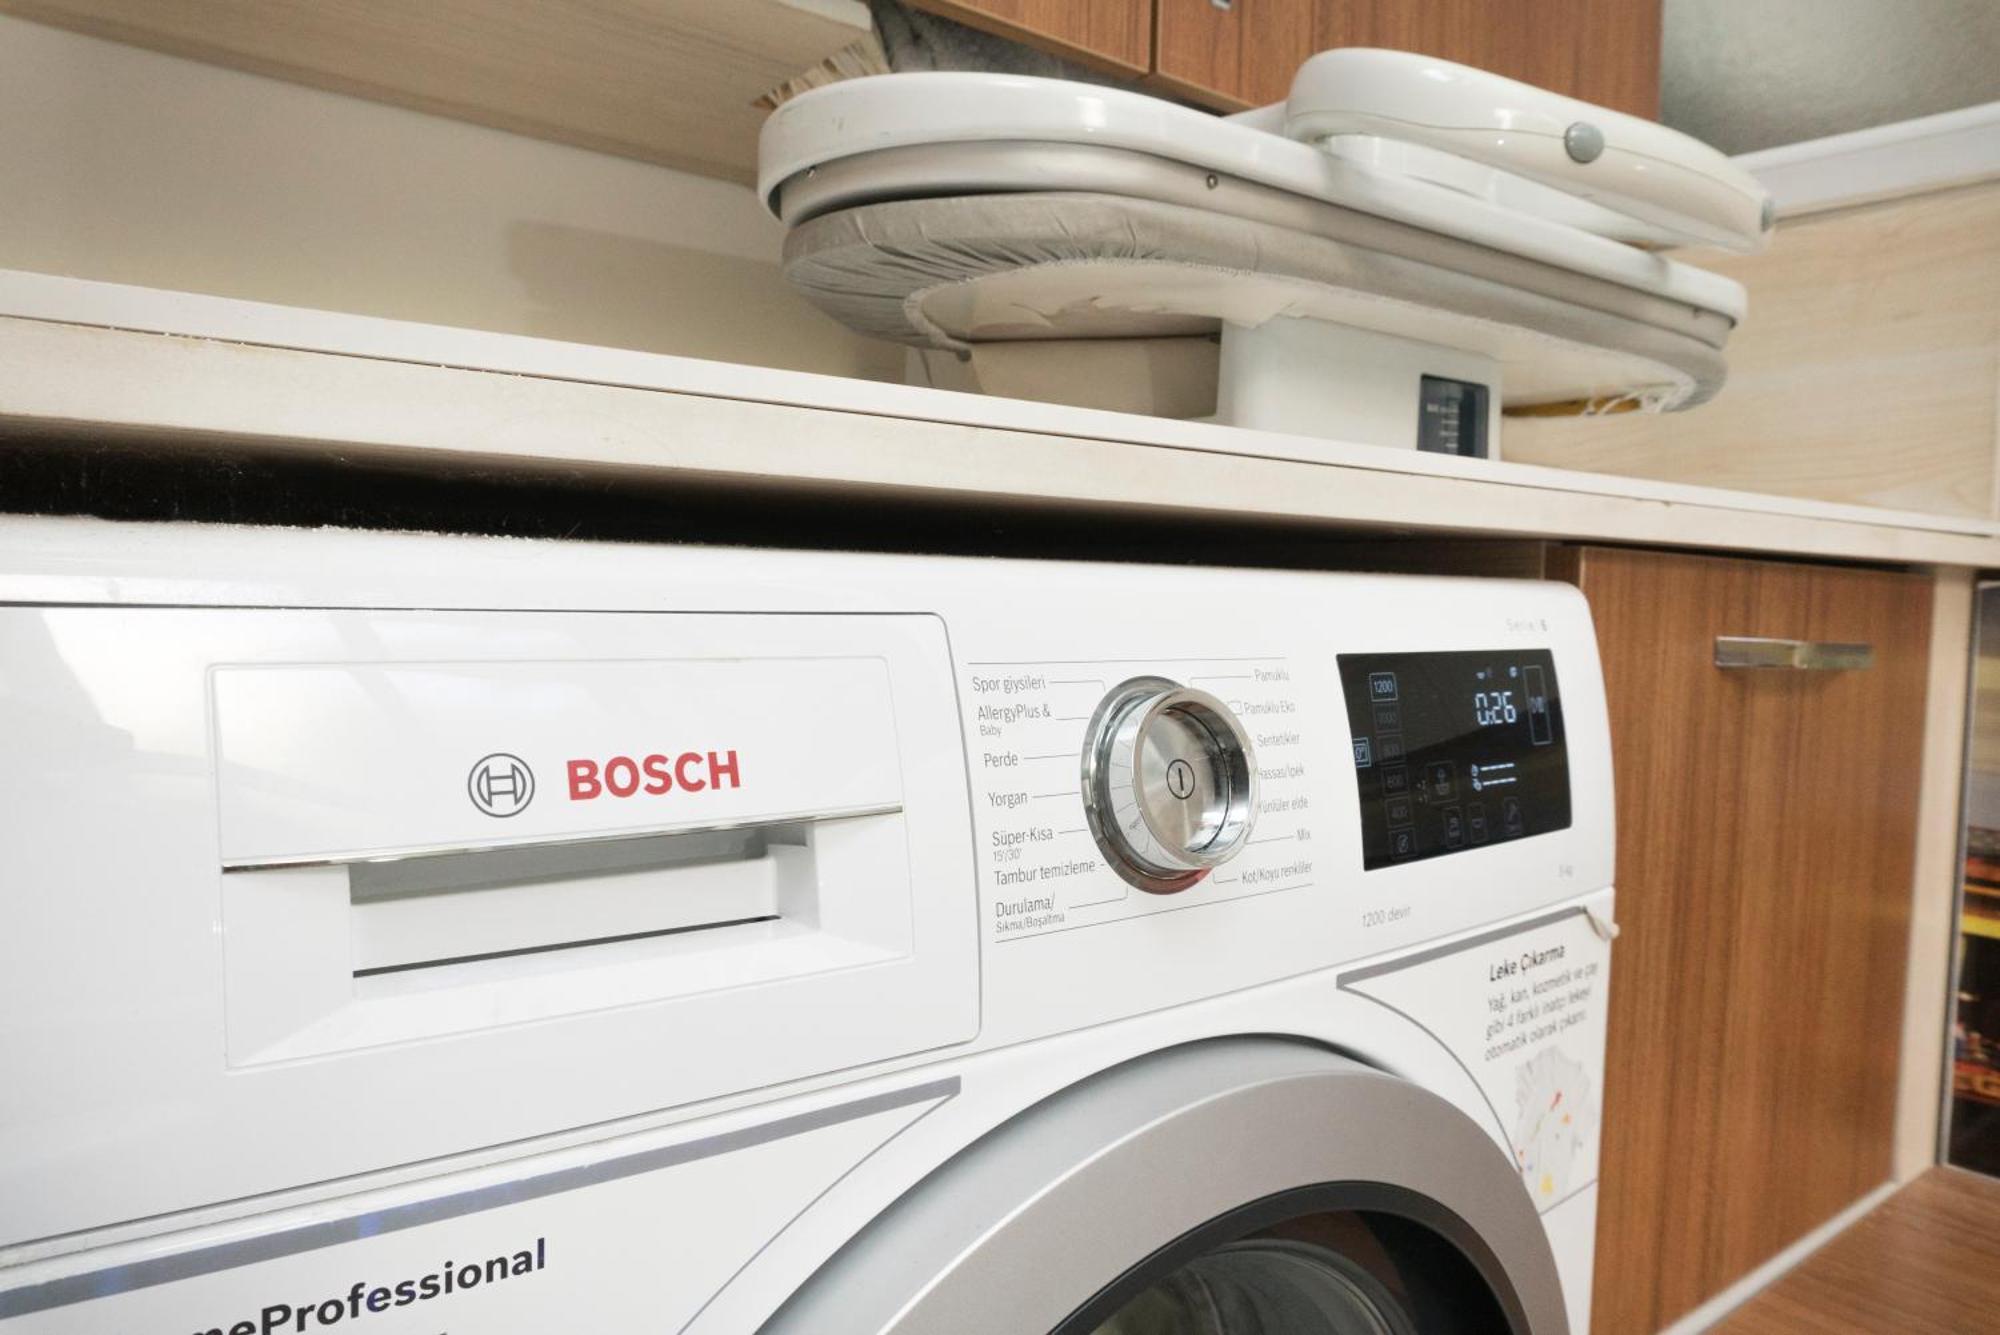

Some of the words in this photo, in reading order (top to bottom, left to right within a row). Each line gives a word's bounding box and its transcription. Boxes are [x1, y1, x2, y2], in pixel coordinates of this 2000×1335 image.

[972, 676, 1001, 694] Spor
[1003, 674, 1046, 694] giysileri
[1254, 667, 1290, 682] Pamuklu
[1373, 680, 1393, 694] 1200
[978, 703, 1041, 723] AllergyPlus
[1043, 703, 1051, 718] &
[1243, 700, 1279, 714] Pamuklu
[1280, 700, 1296, 714] Eko
[1475, 691, 1517, 726] 0:26
[980, 724, 1002, 737] Baby
[984, 751, 1018, 768] Perde
[567, 750, 740, 801] BOSCH
[988, 792, 1028, 809] Yorgan
[1297, 827, 1312, 842] Mix
[994, 868, 1037, 886] Tambur
[1040, 860, 1095, 880] temizleme
[995, 890, 1055, 918] Durulama/
[1363, 909, 1386, 928] 1200
[1387, 906, 1411, 922] devir
[1490, 959, 1517, 982] Leke
[1521, 945, 1565, 975] Çıkarma
[193, 1237, 545, 1335] eProfessional
